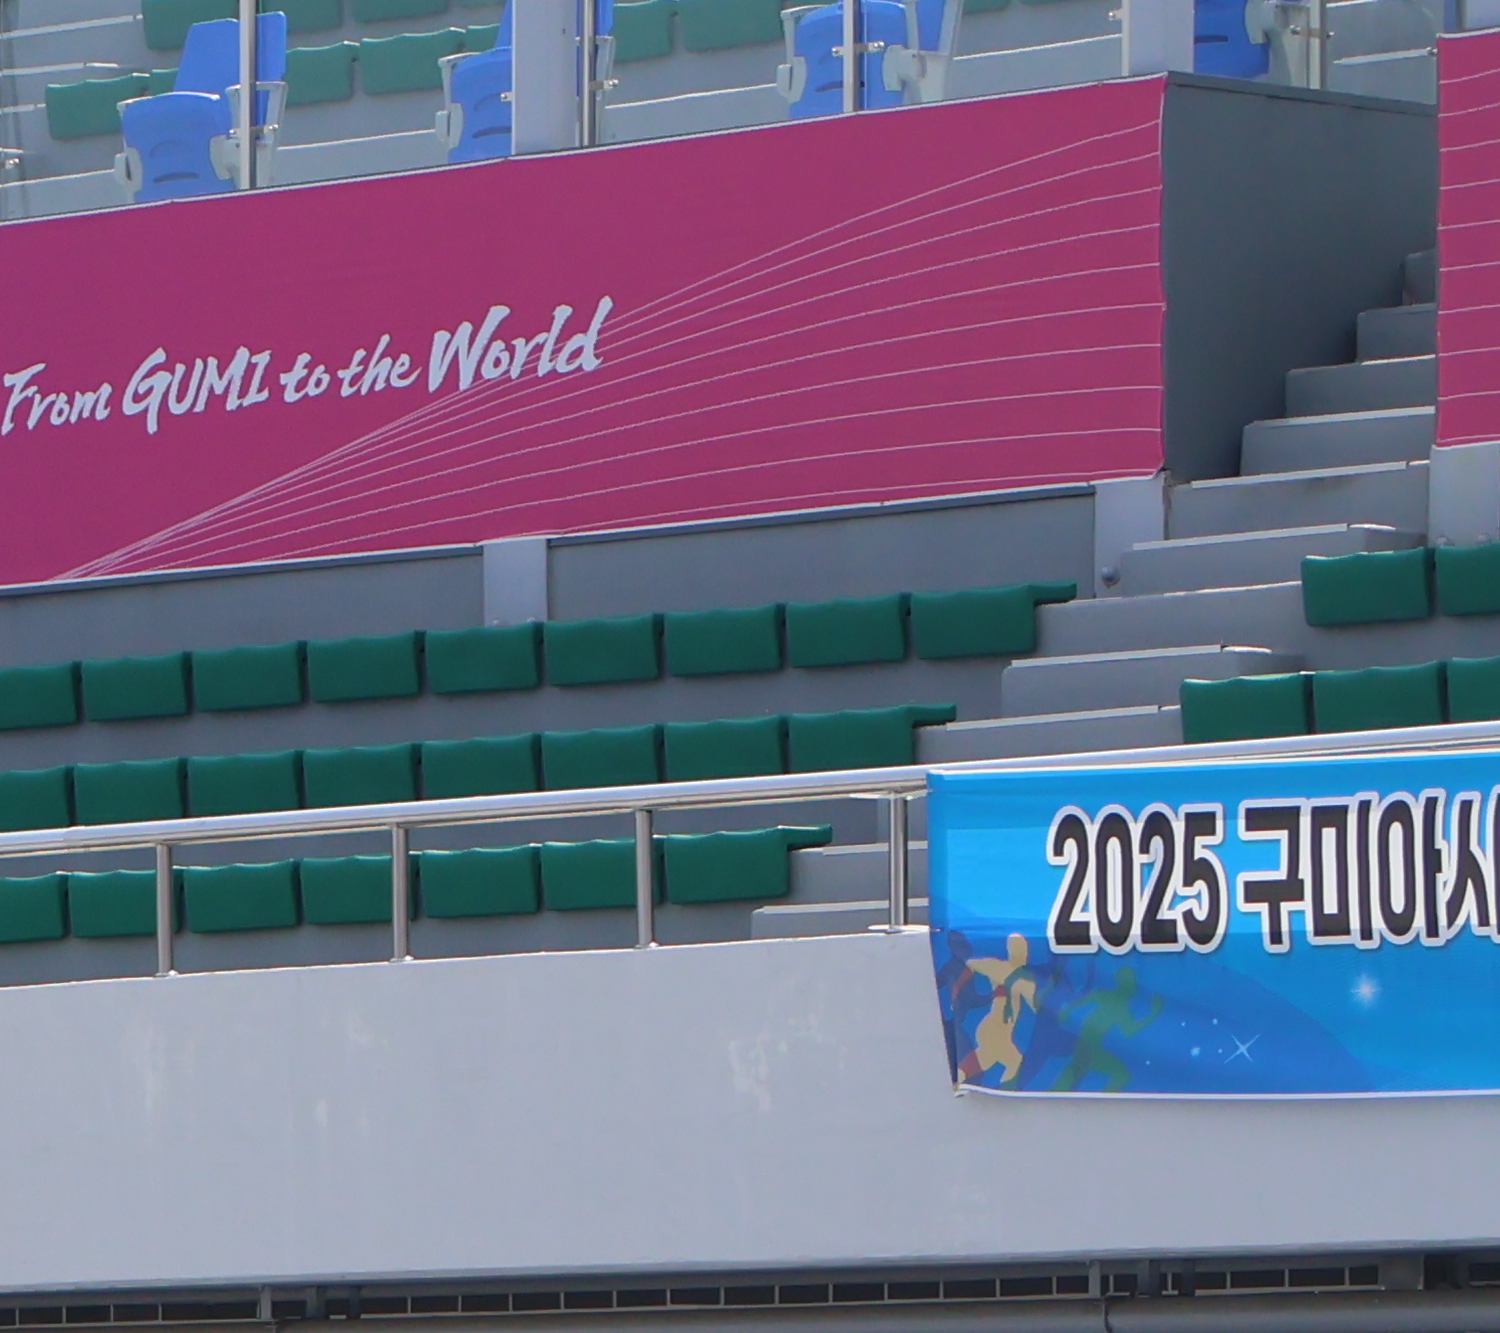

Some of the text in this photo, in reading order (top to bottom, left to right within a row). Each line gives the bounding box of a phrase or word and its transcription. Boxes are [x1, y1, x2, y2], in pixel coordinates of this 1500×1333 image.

[1, 362, 112, 436] From
[122, 345, 273, 435] GUMI
[279, 352, 331, 403] to
[337, 333, 422, 396] the
[427, 294, 614, 393] World
[1050, 807, 1225, 949] 2025
